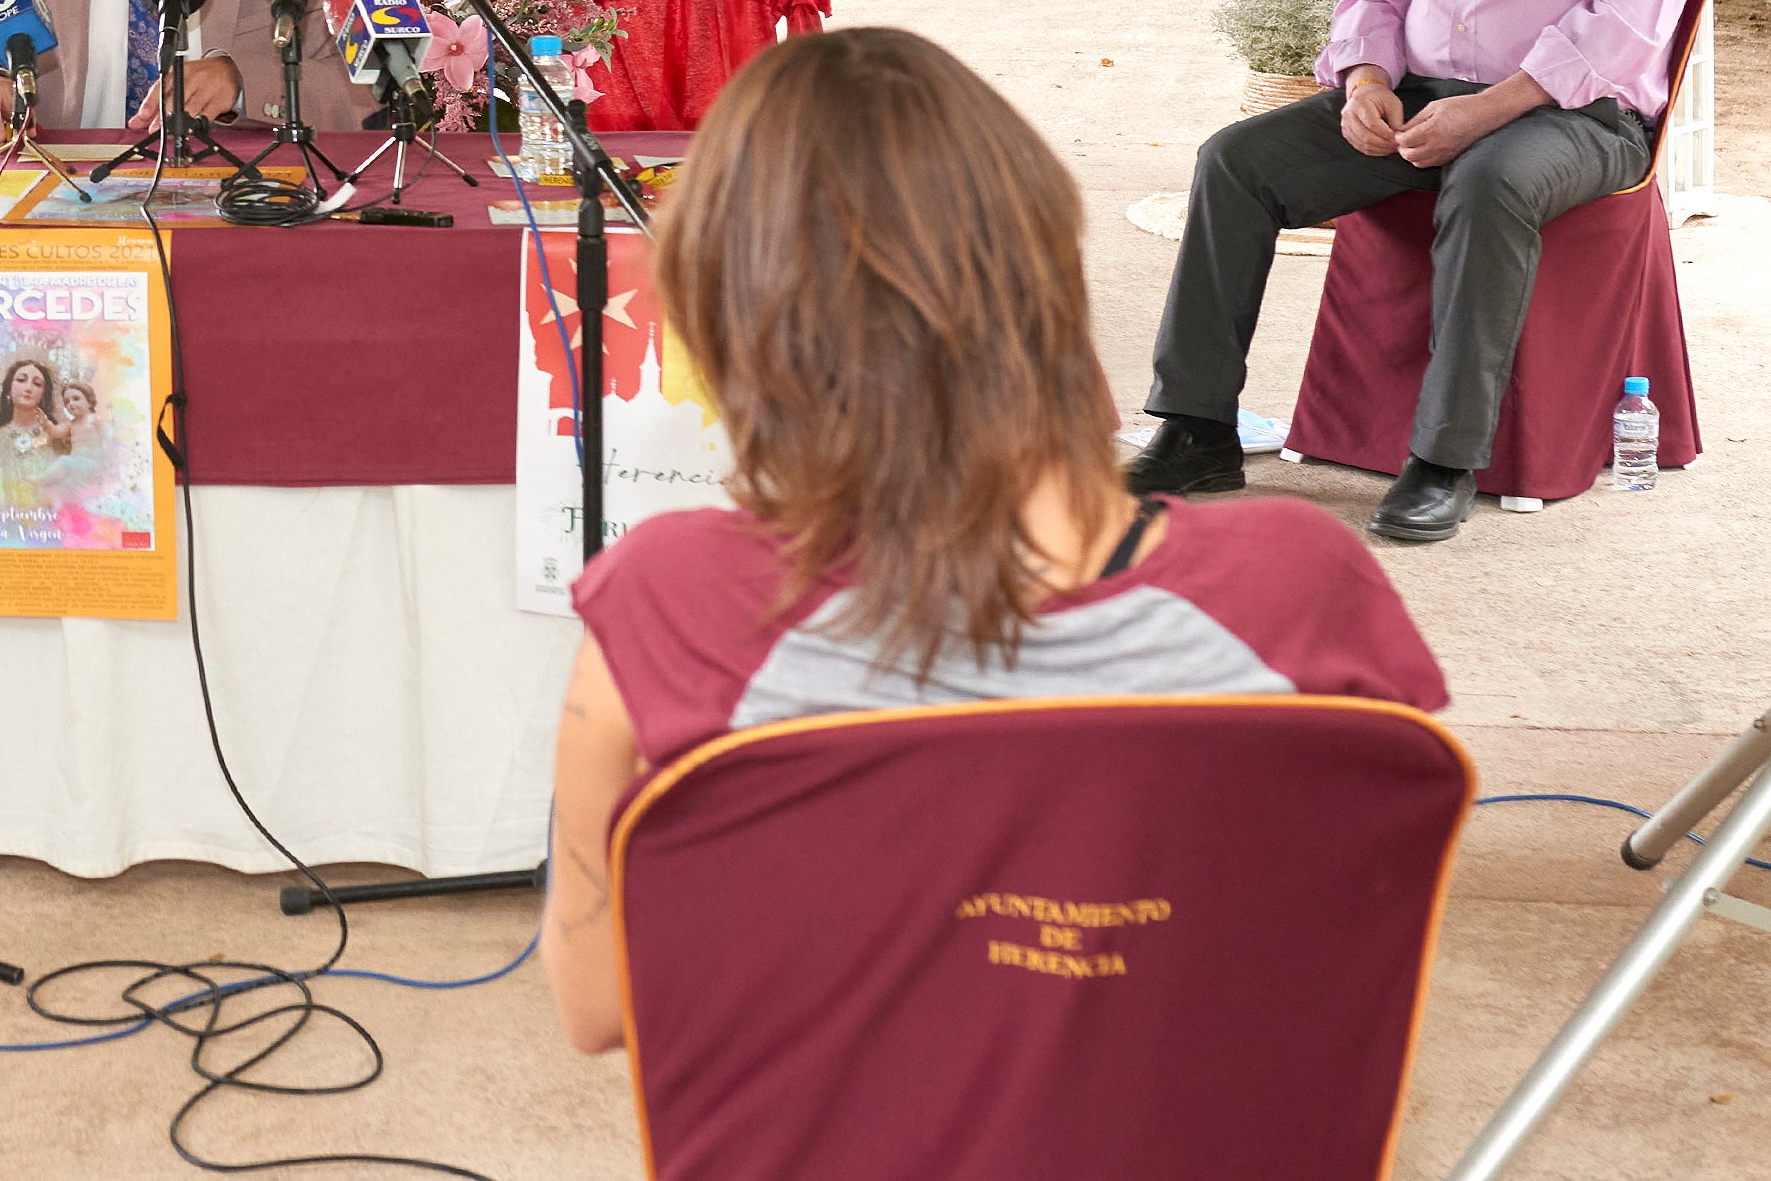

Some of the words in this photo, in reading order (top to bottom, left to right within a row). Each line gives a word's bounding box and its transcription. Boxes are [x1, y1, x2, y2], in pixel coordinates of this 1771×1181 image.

[384, 26, 420, 34] SURCO
[26, 244, 101, 259] CULTOS
[109, 245, 155, 260] 2021
[48, 276, 94, 288] MADRE
[96, 277, 115, 288] DE
[116, 277, 138, 288] LAS
[18, 523, 64, 542] Virgen
[1039, 923, 1083, 950] DE
